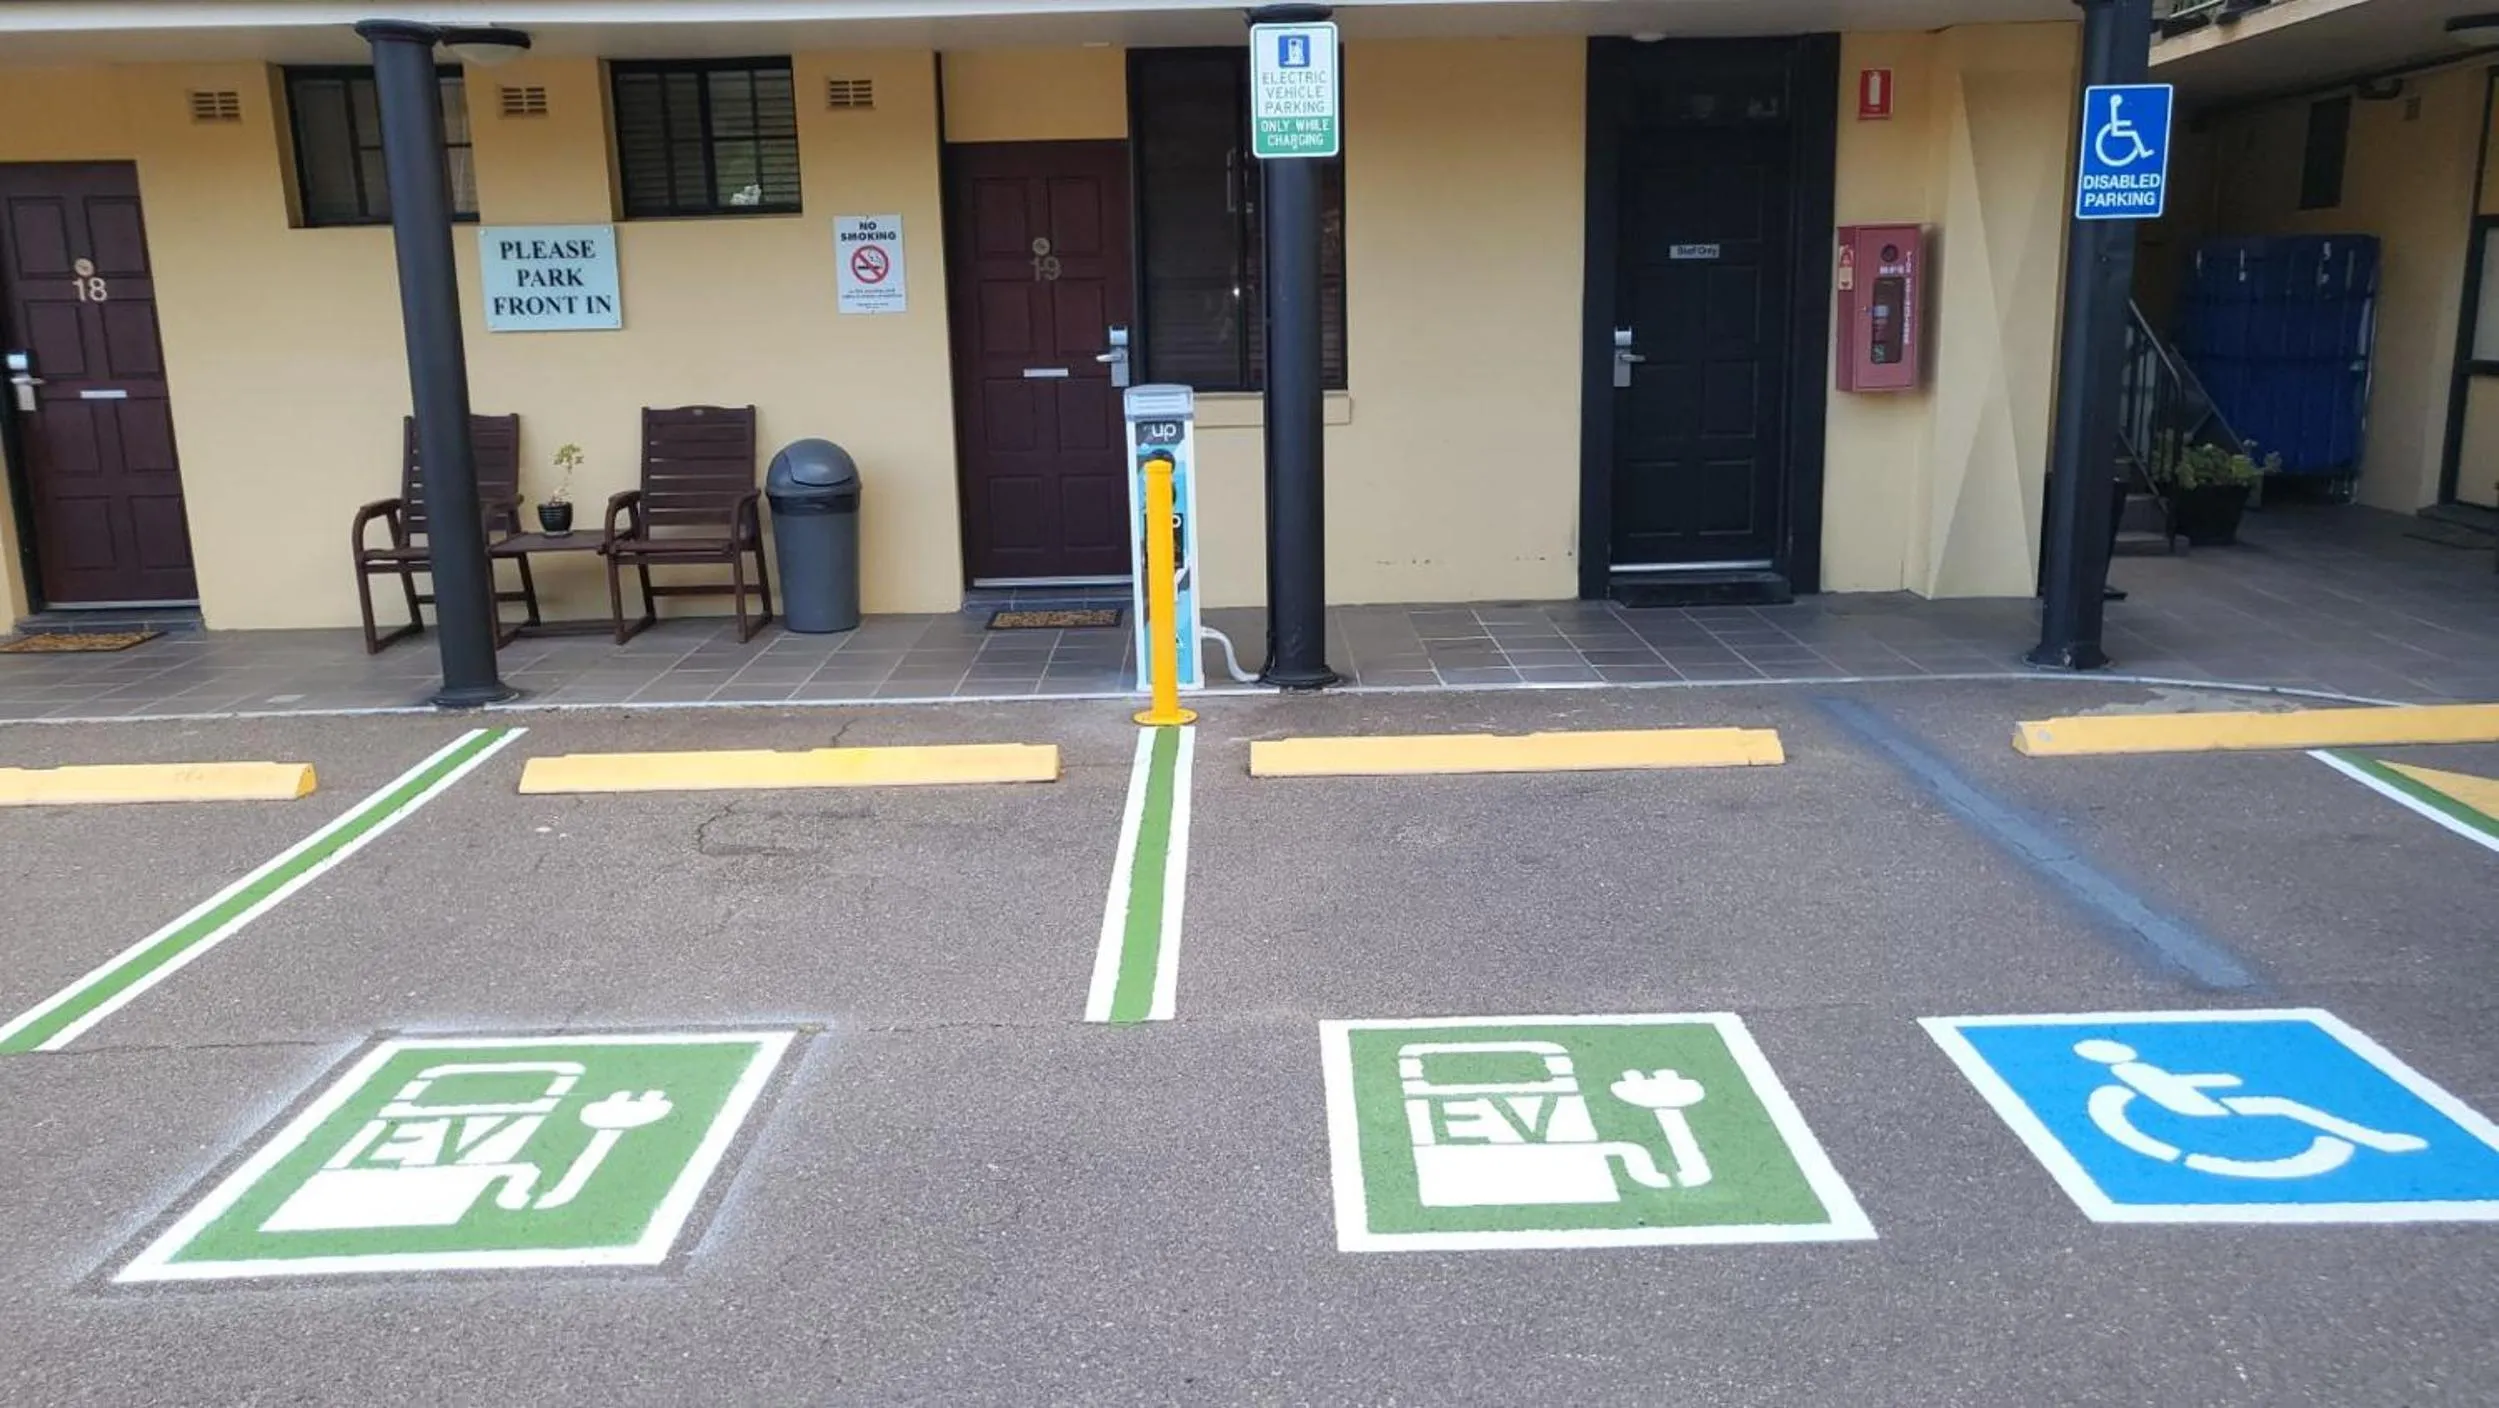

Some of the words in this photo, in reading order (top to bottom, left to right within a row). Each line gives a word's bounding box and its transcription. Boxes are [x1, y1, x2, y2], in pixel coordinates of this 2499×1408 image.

[1262, 71, 1327, 85] ELECTRIC
[1265, 85, 1324, 99] VEHICLE
[1265, 101, 1324, 114] PARKING
[1260, 119, 1290, 133] ONLY
[1296, 119, 1331, 132] WHILE
[1267, 133, 1324, 147] CHARGING
[2083, 173, 2160, 190] DISABLED
[2084, 191, 2155, 208] PARKING
[859, 221, 877, 231] NO
[840, 231, 897, 242] SMOKING
[499, 239, 596, 260] PLEASE
[1029, 256, 1062, 282] 19
[516, 268, 585, 288] PARK
[71, 276, 108, 302] 18
[493, 295, 578, 316] FRONT
[585, 294, 612, 315] IN
[1151, 423, 1177, 442] up
[1427, 1094, 1558, 1144] EV
[346, 1115, 523, 1169] EV
